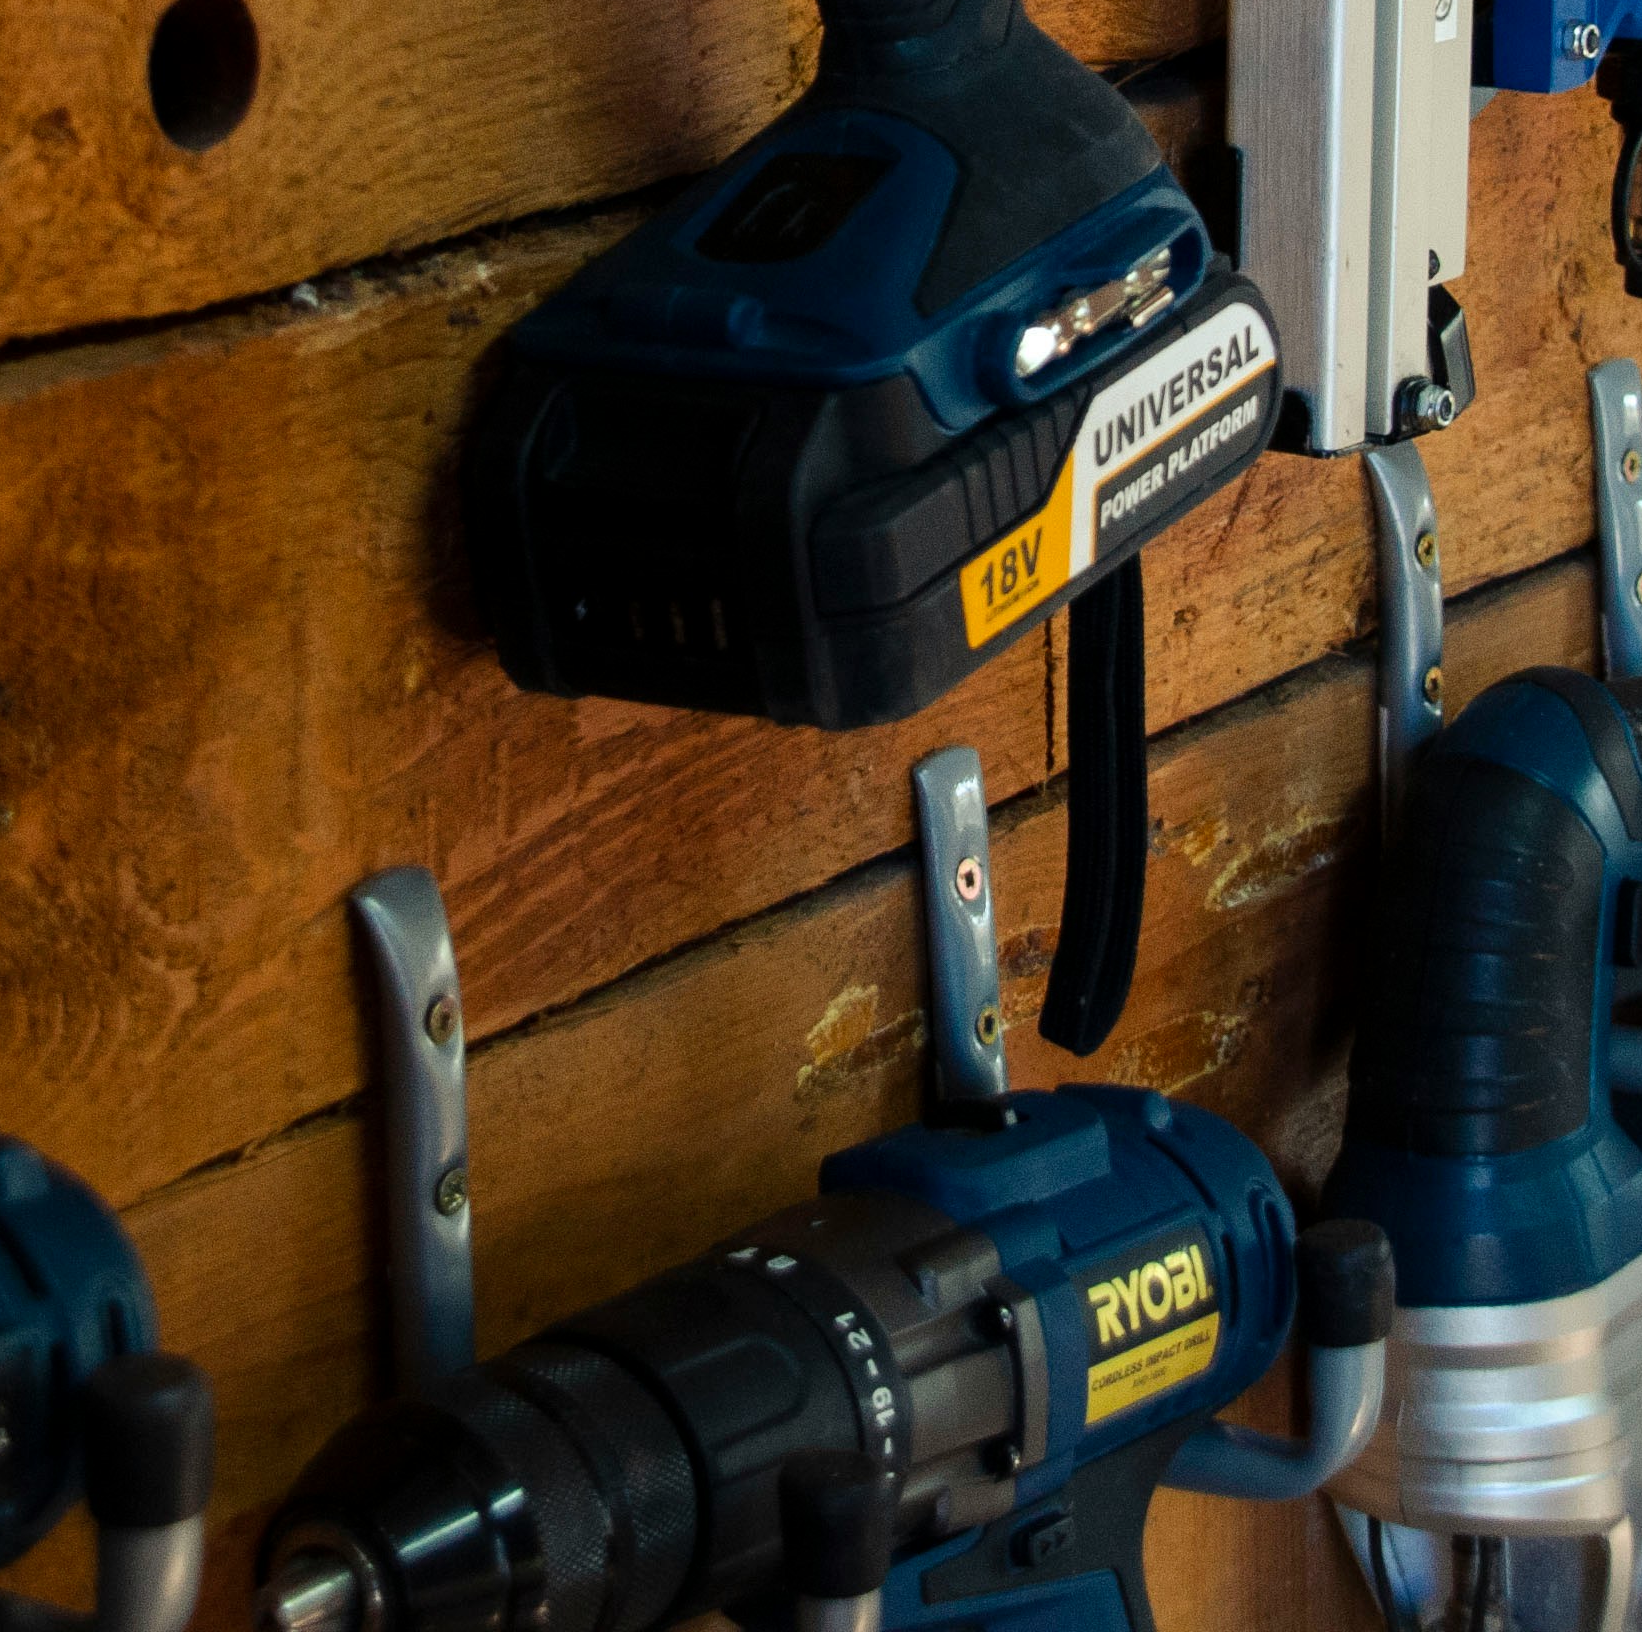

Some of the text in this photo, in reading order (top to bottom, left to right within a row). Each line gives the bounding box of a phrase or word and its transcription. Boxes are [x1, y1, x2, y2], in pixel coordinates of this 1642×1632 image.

[1093, 324, 1259, 467] UNIVERSAL
[1100, 394, 1259, 529] POWER PLATFORM
[980, 526, 1043, 607] 18V
[1087, 1244, 1209, 1344] RYOBI
